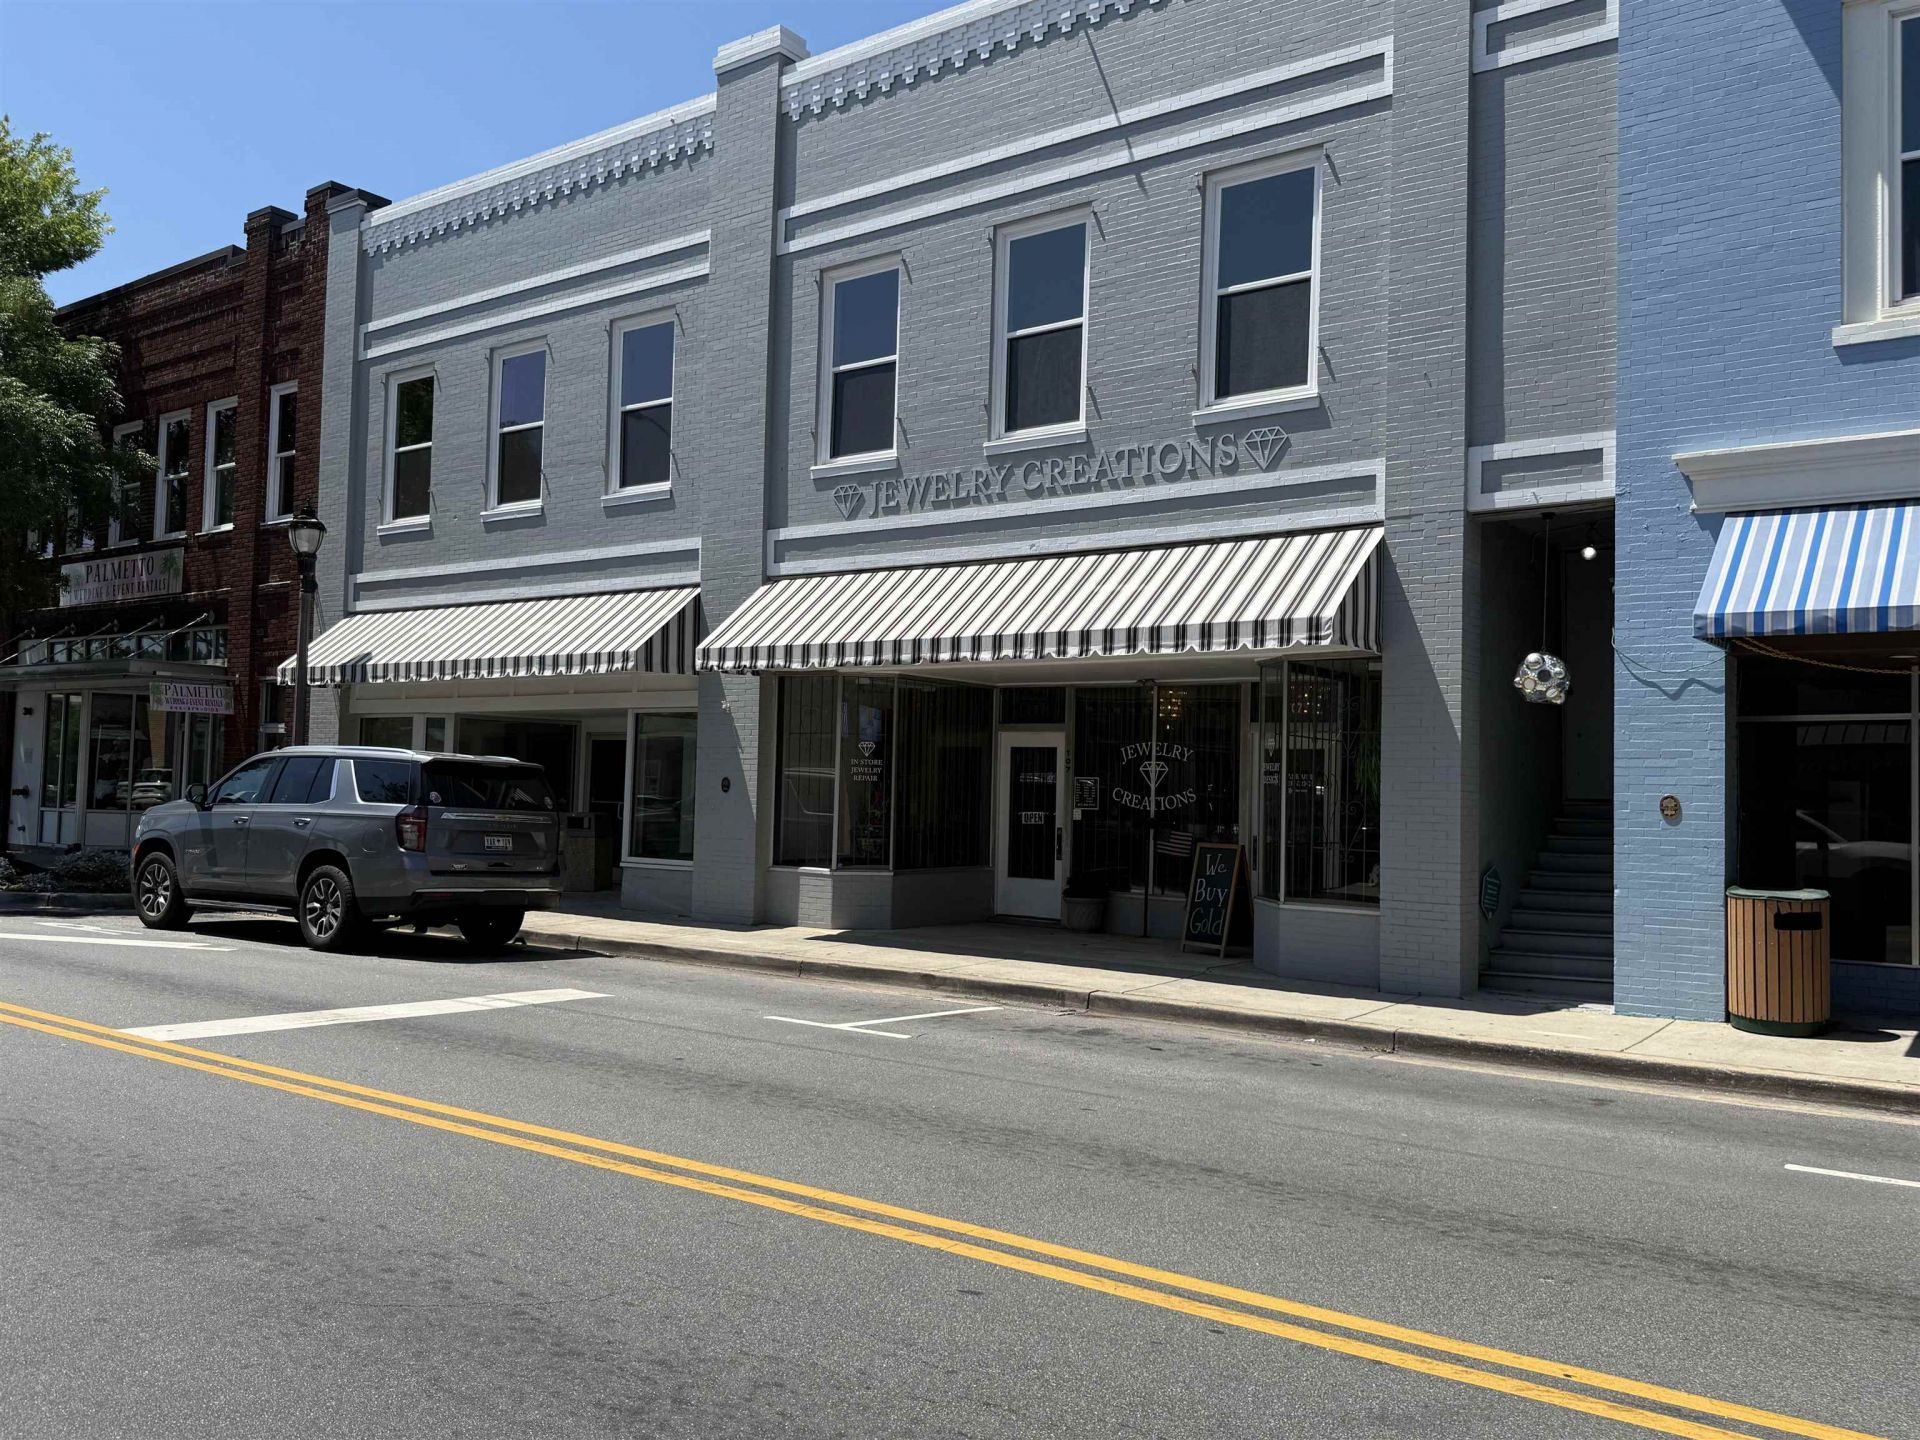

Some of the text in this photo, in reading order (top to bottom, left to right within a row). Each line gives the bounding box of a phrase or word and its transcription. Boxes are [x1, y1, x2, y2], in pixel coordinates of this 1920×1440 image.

[869, 433, 1238, 519] JEWELRY CREATIONS
[86, 557, 154, 583] PALMETTO
[137, 578, 166, 593] RENTALS
[165, 684, 223, 698] PALMETTO
[850, 758, 859, 766] IN
[1120, 742, 1194, 765] JEWELRY
[850, 767, 882, 775] JEWELRY
[853, 774, 878, 782] REPAIR
[1112, 787, 1197, 811] CREATIONS
[1024, 812, 1043, 823] OPEN
[1206, 853, 1228, 876] We
[1194, 878, 1229, 908] Buy
[1189, 907, 1226, 937] Gold
